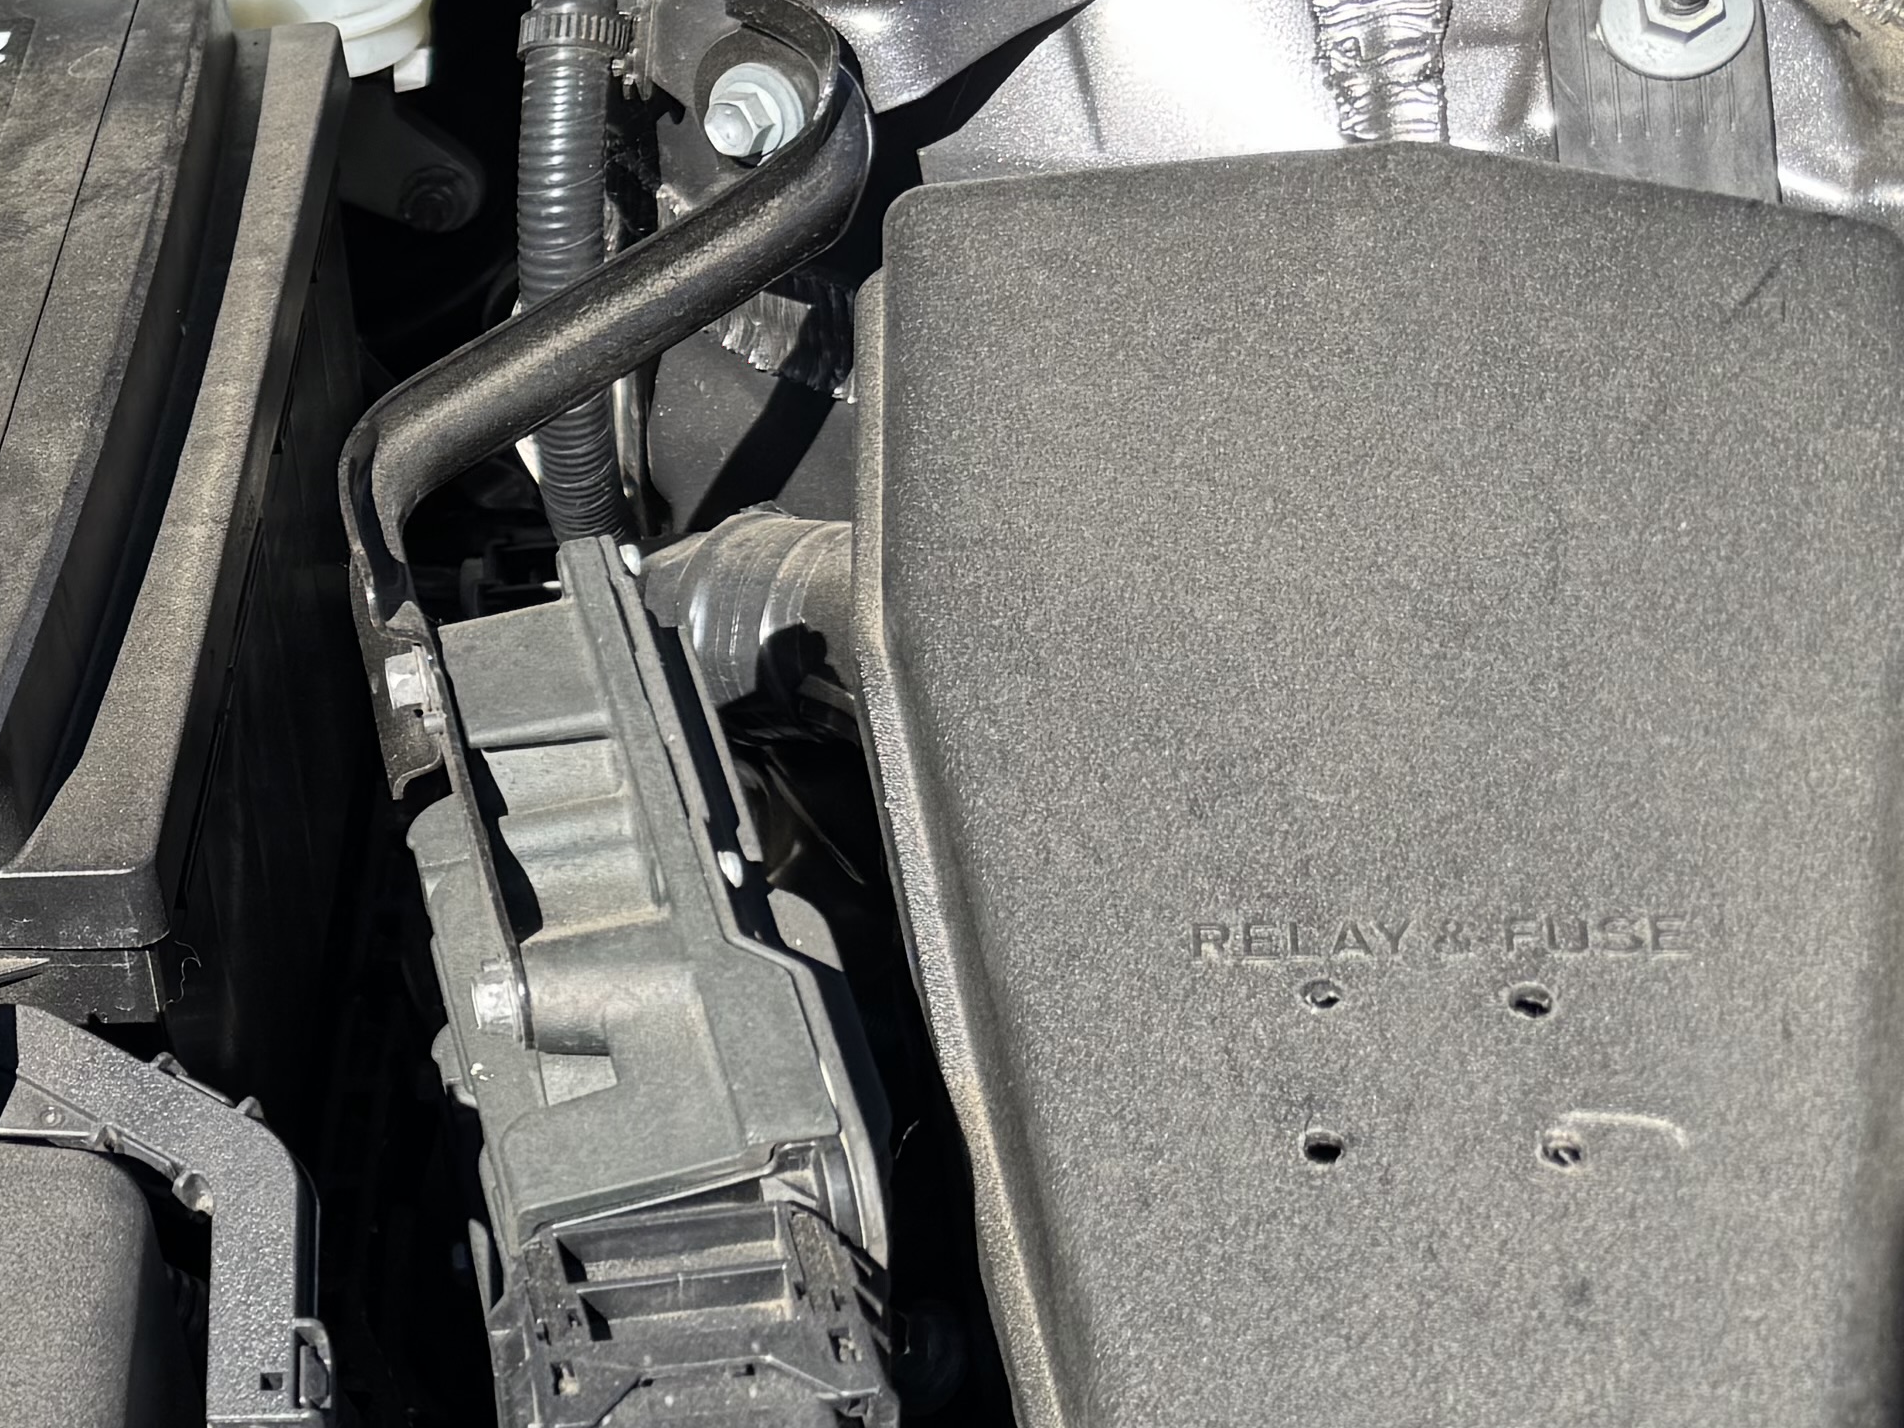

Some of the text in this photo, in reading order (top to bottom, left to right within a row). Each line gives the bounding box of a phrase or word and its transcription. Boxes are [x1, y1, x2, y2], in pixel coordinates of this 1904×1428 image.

[1192, 915, 1692, 962] RELAY & FUSE
